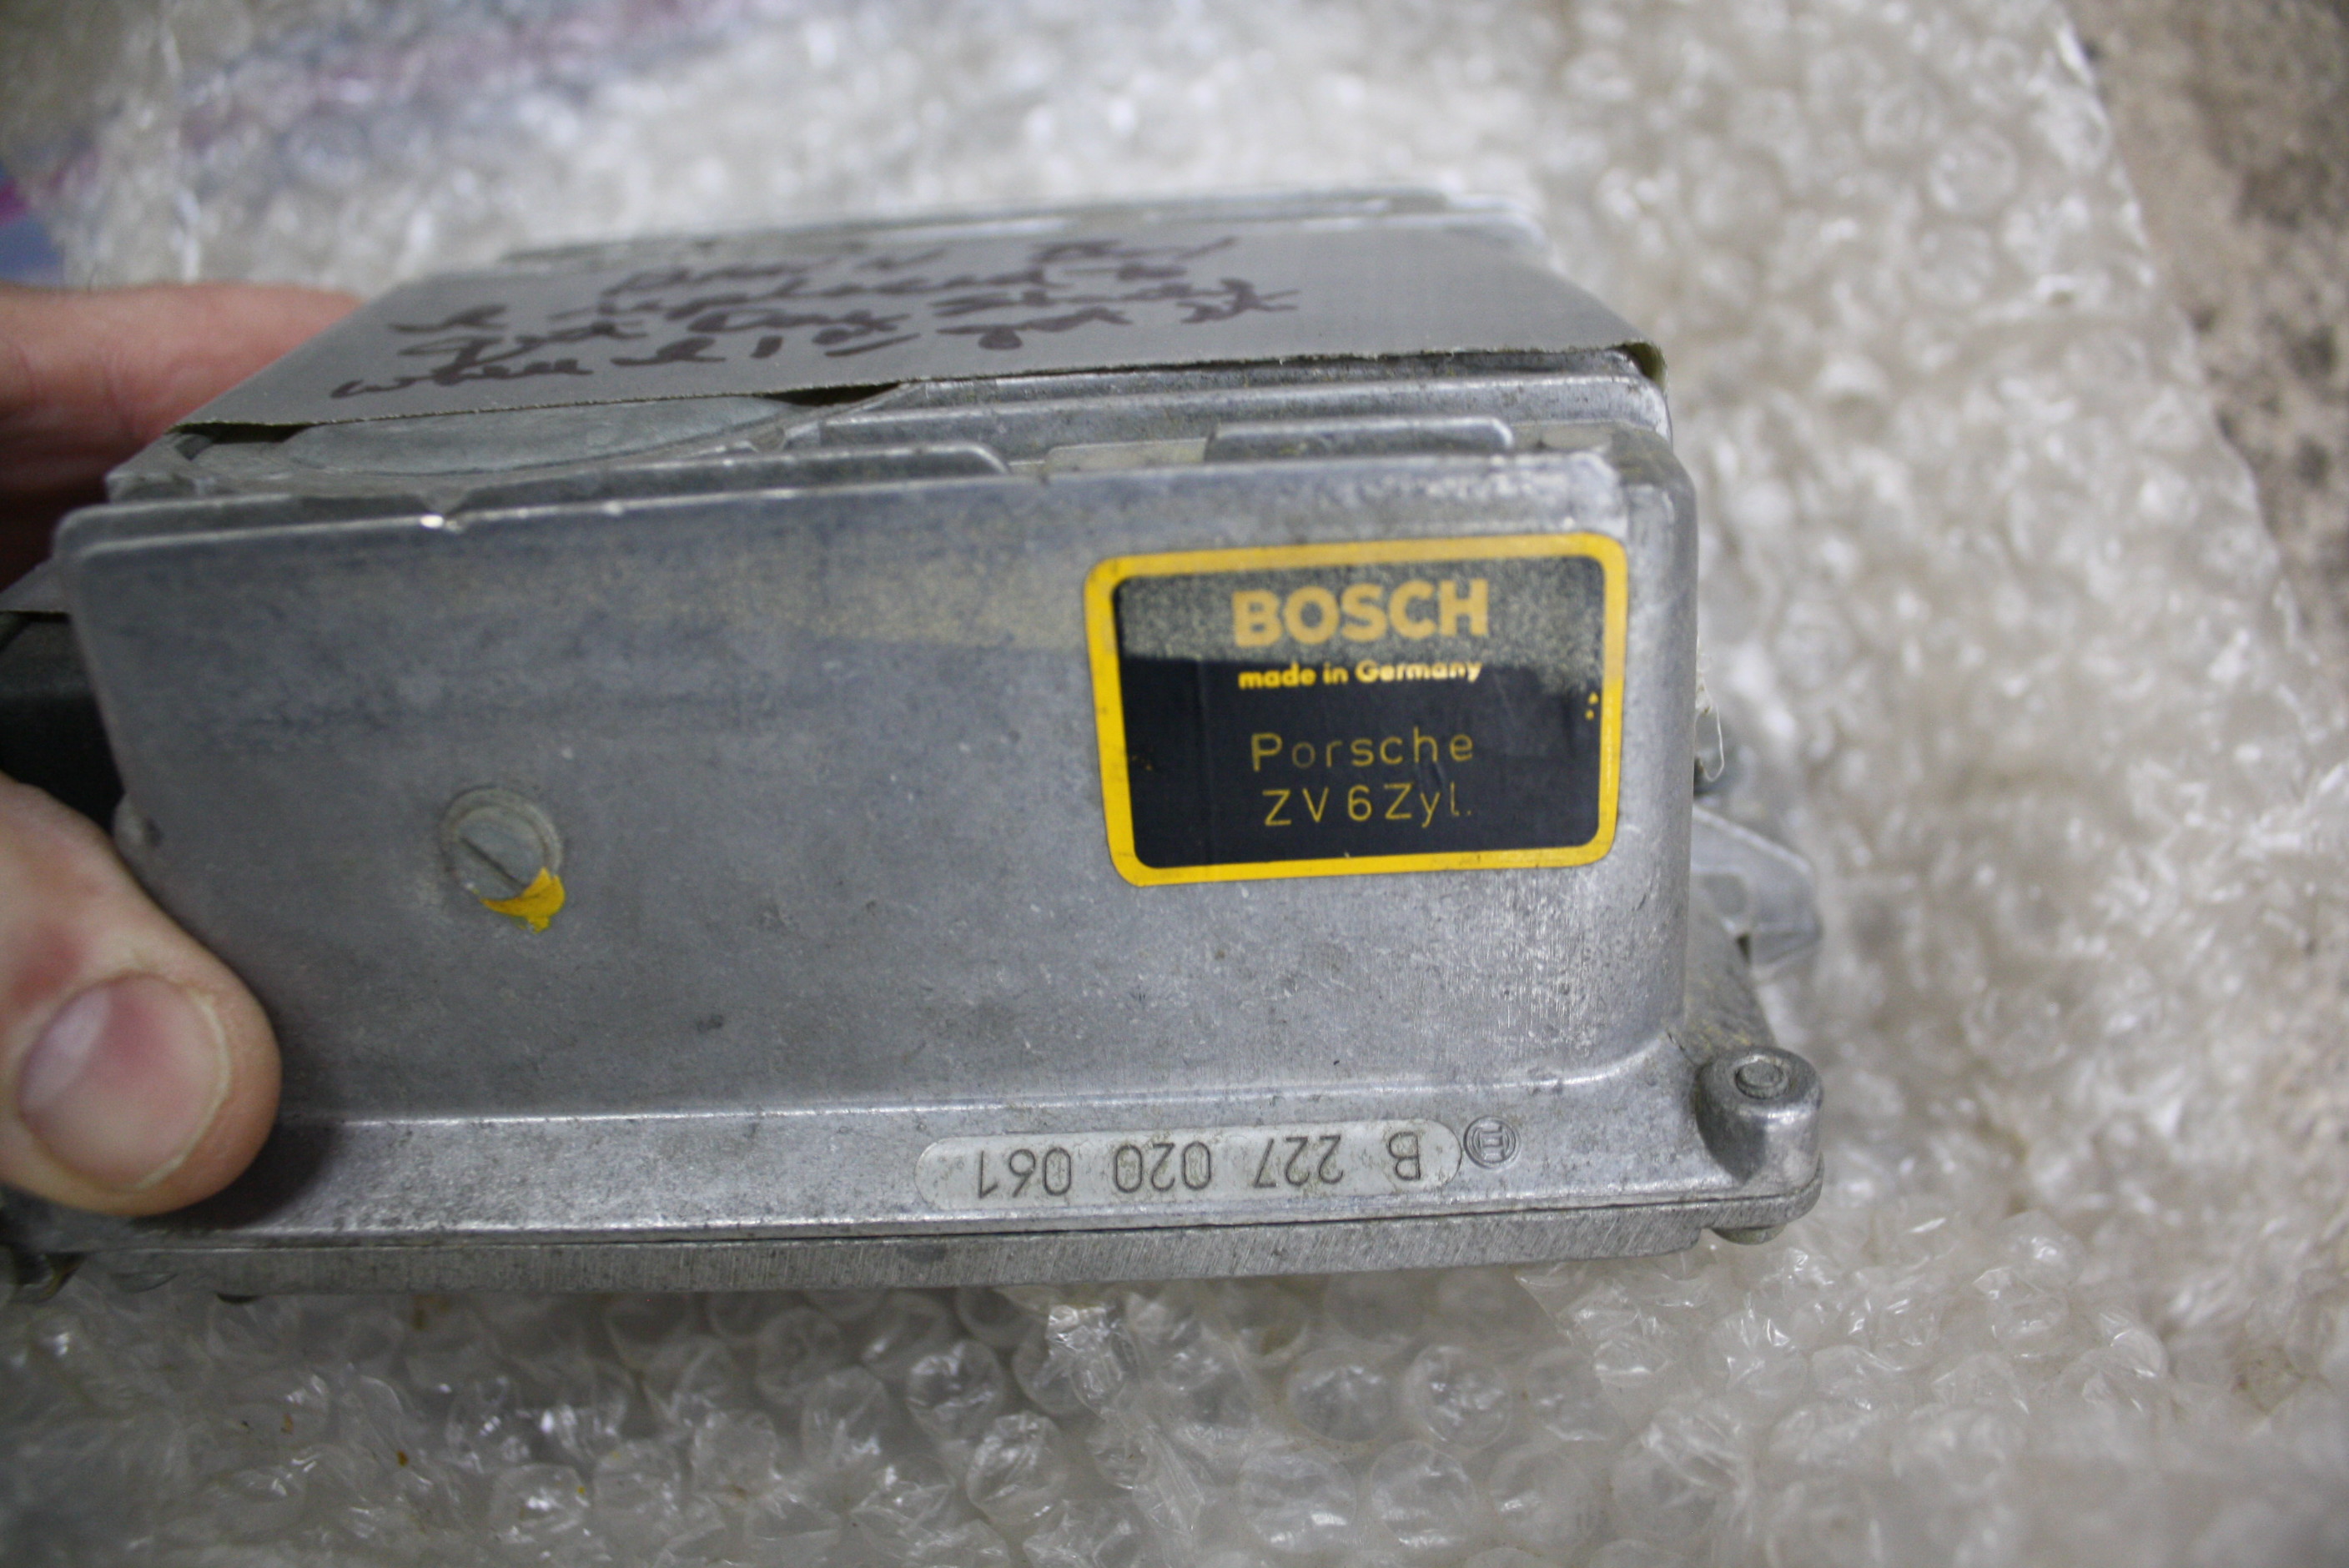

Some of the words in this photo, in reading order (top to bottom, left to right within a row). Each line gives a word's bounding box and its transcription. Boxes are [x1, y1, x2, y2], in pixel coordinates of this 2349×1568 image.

[1231, 579, 1488, 648] BOSCH
[1239, 662, 1316, 690] made
[1323, 662, 1349, 685] in
[1355, 660, 1482, 683] Germany
[1251, 726, 1473, 771] Porsche
[978, 1147, 1072, 1199] 061
[1114, 1141, 1210, 1193] 020
[1253, 1134, 1344, 1189] 227
[1388, 1130, 1421, 1182] B
